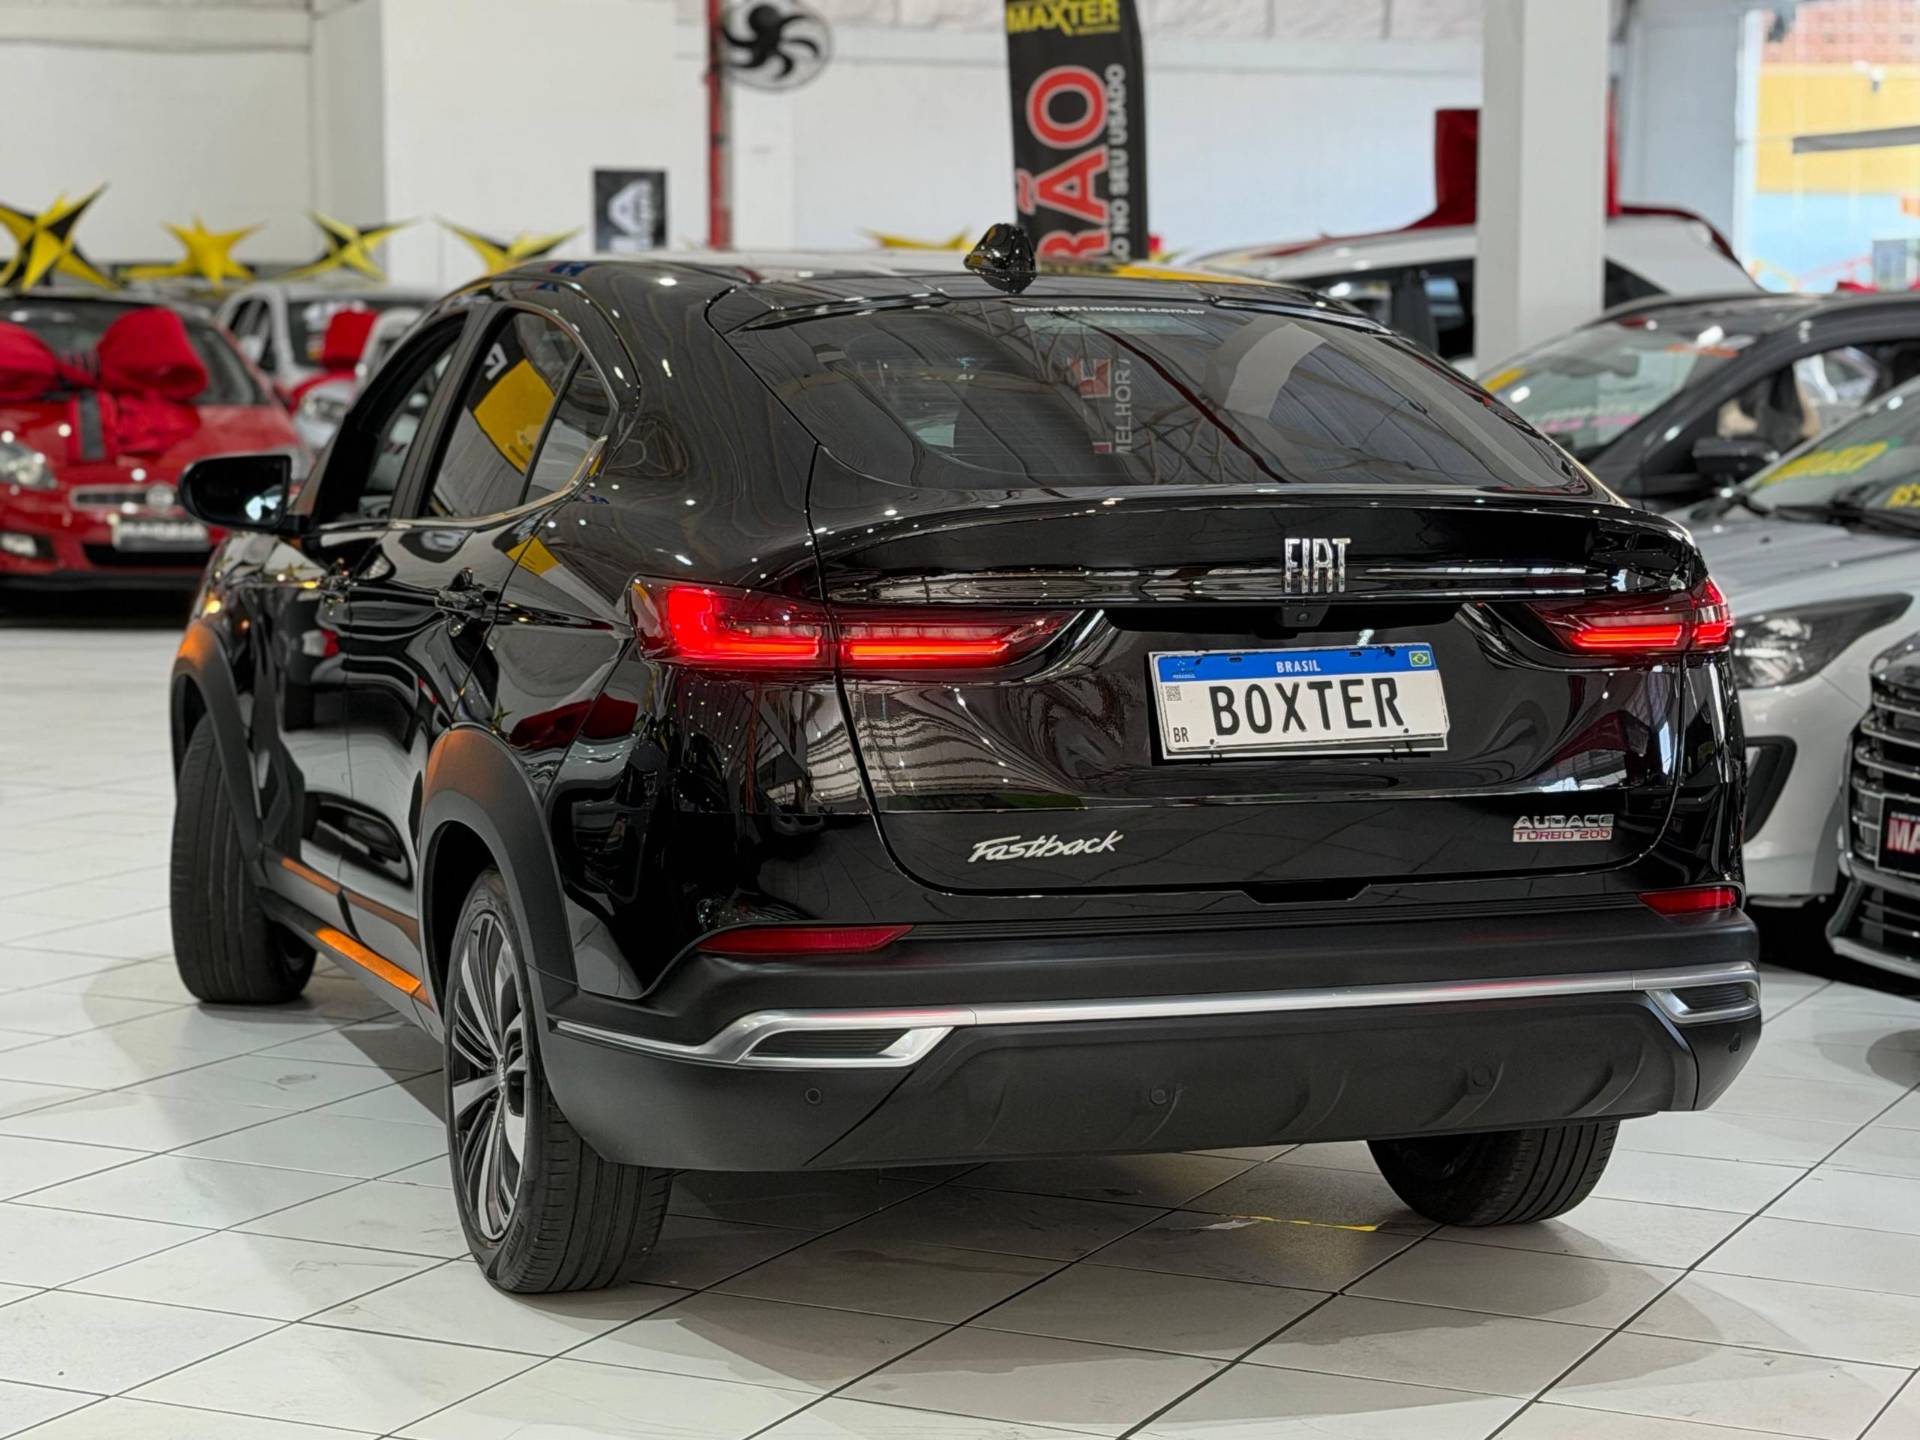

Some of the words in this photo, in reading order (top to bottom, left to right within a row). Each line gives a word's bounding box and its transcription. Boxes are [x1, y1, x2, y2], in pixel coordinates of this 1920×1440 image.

[1006, 0, 1119, 36] MAXTER
[1104, 63, 1128, 146] USADO
[1108, 148, 1129, 196] SEU
[1110, 199, 1130, 235] NO
[1284, 537, 1352, 594] FIAT
[1275, 659, 1322, 674] BRASIL
[1208, 677, 1405, 736] BOXTER
[1172, 726, 1190, 744] BR
[1512, 813, 1615, 829] AUDACE
[1516, 831, 1574, 841] TURBO
[1579, 829, 1611, 839] 200
[967, 829, 1125, 863] Fastback
